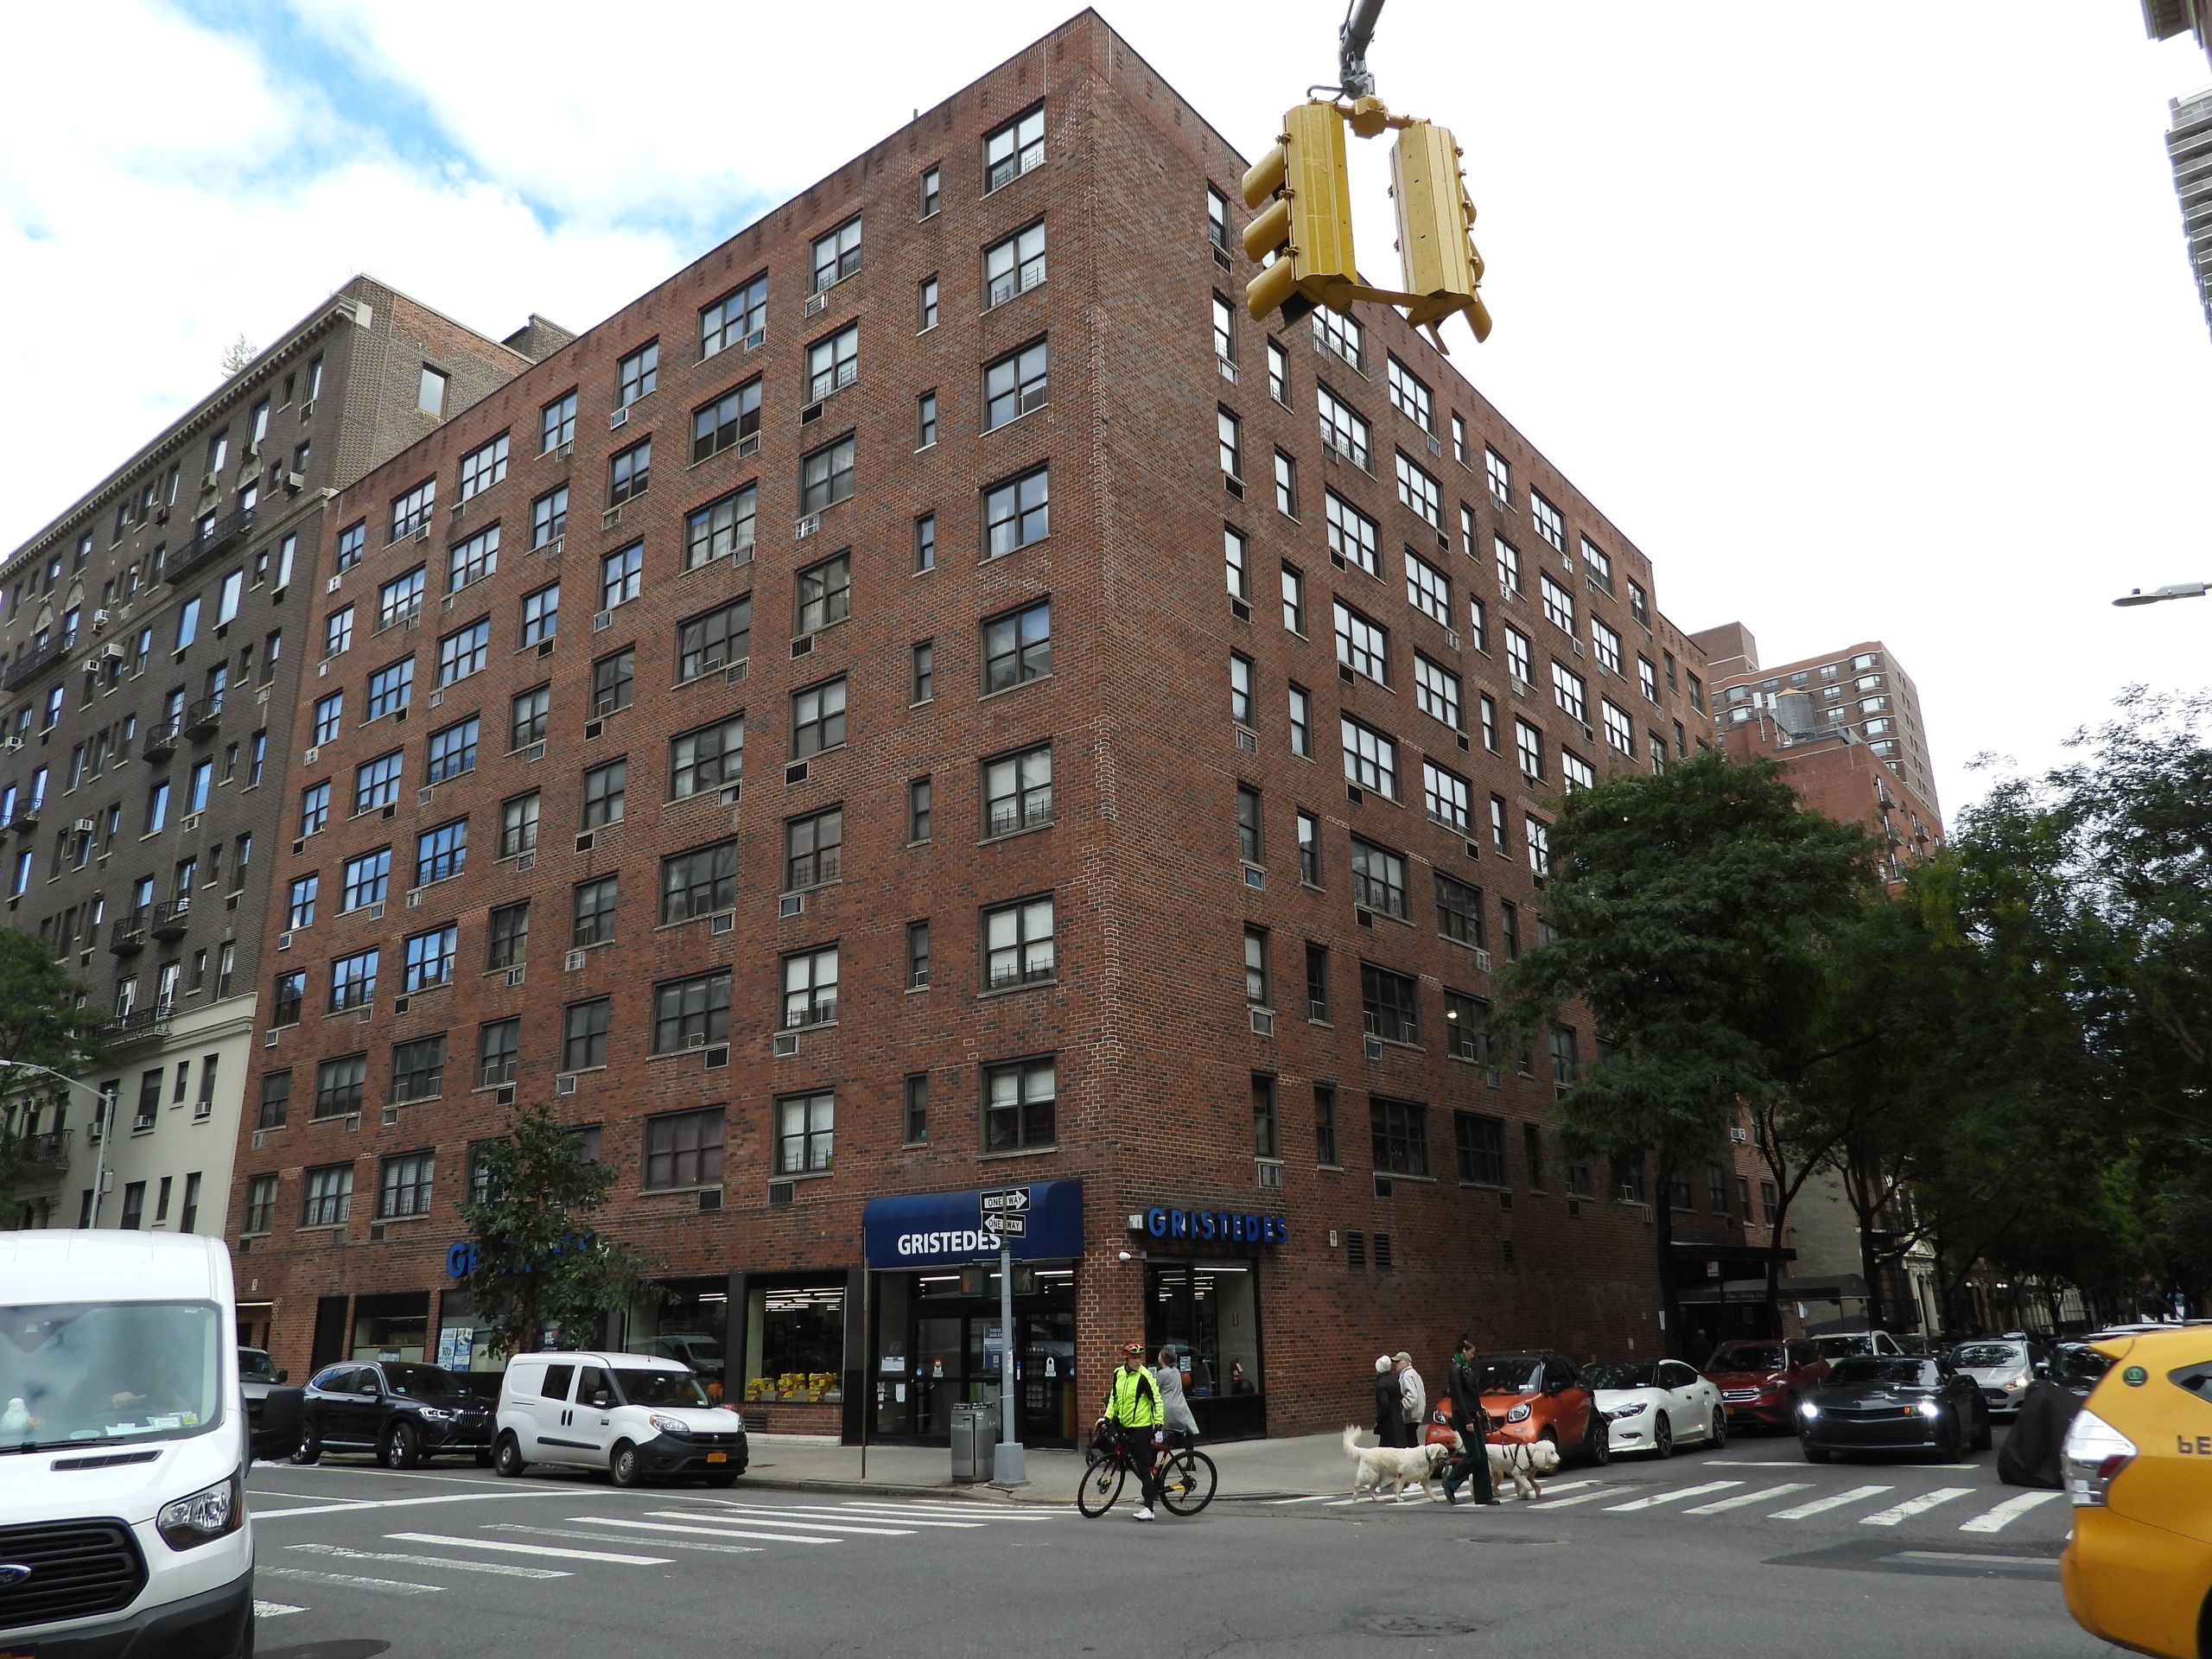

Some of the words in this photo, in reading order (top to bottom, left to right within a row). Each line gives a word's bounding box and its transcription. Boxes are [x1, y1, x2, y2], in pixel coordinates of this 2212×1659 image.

[988, 1197, 1002, 1207] ONE
[1007, 1195, 1022, 1205] WAY
[988, 1218, 1001, 1228] ONE
[1007, 1221, 1020, 1230] WAY
[1147, 1207, 1288, 1244] GRISTEDES
[897, 1230, 1001, 1255] GRISTEDES
